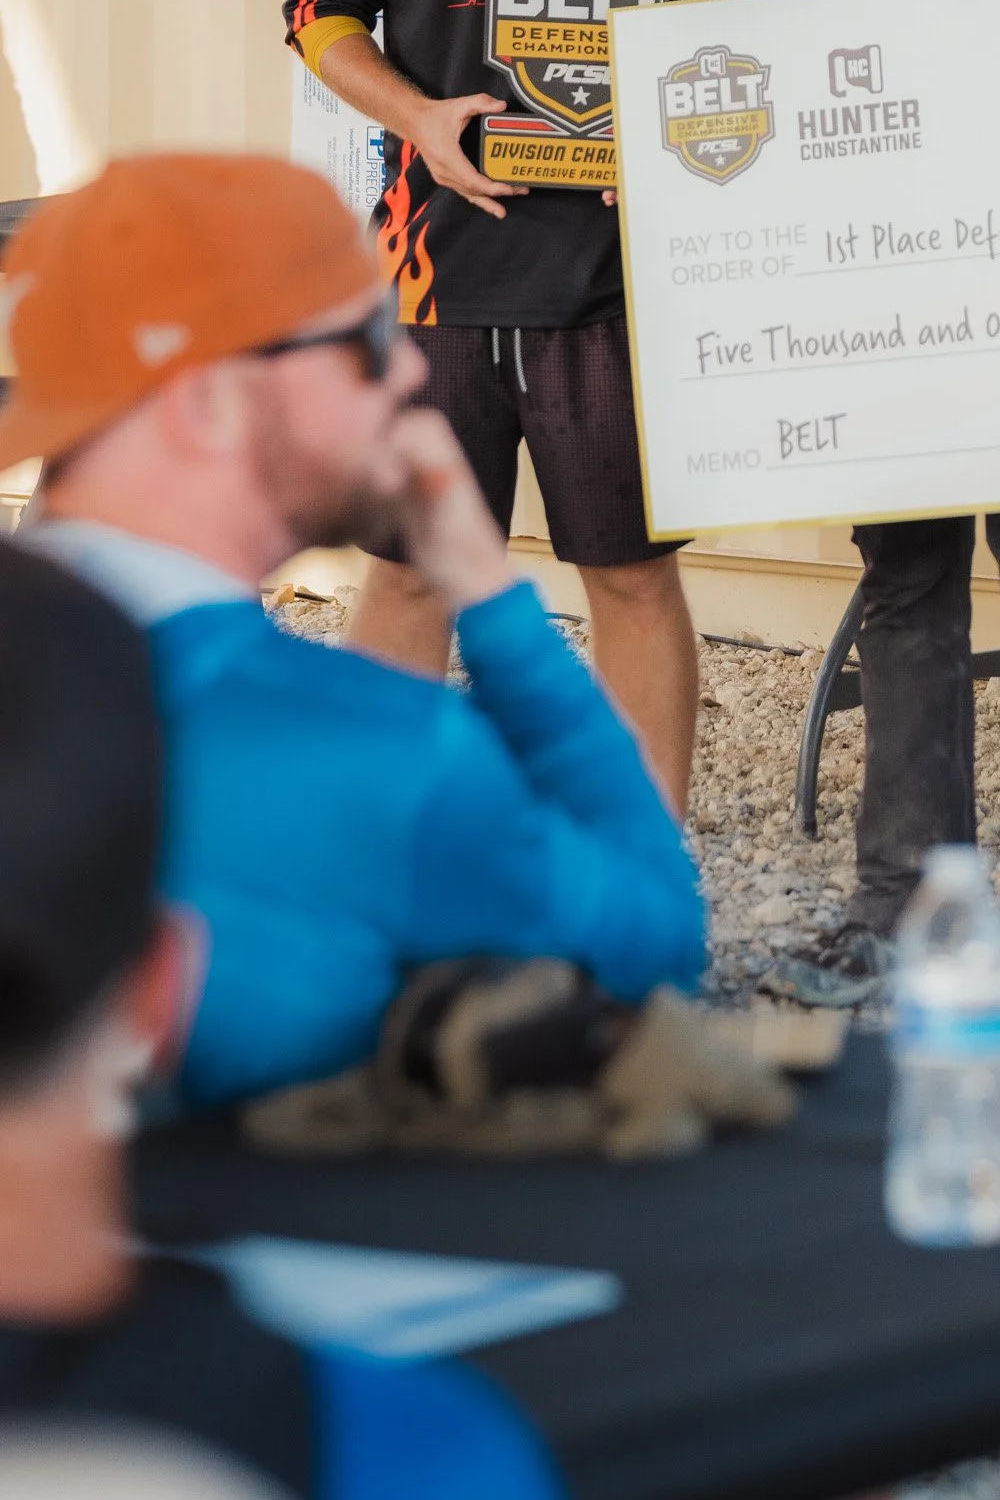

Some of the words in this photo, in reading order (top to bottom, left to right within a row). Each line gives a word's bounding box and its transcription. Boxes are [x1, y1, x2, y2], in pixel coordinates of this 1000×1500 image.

[512, 26, 609, 44] DEFENS
[512, 41, 609, 56] CHAMPION
[847, 57, 869, 79] HC
[665, 73, 764, 117] BELT
[676, 113, 760, 132] DEFENSIVE
[676, 123, 761, 140] CHAMPIONSHIP
[797, 98, 921, 141] HUNTER
[490, 141, 567, 162] DIVISION
[697, 138, 742, 155] PCSL
[800, 132, 923, 162] CONSTANTINE
[365, 161, 378, 208] PRECISI
[511, 165, 577, 179] DEFENSIVE
[580, 169, 617, 181] PRACT
[669, 233, 713, 258] PAY
[722, 230, 754, 253] TO
[761, 224, 808, 248] THE
[825, 222, 859, 265] 1st
[872, 222, 943, 261] Place
[671, 254, 754, 287] ORDER
[762, 254, 795, 277] OF
[696, 329, 754, 375] Five
[760, 312, 906, 362] Thousand
[918, 305, 974, 347] and
[776, 413, 848, 460] BELT
[686, 449, 762, 475] MEMO
